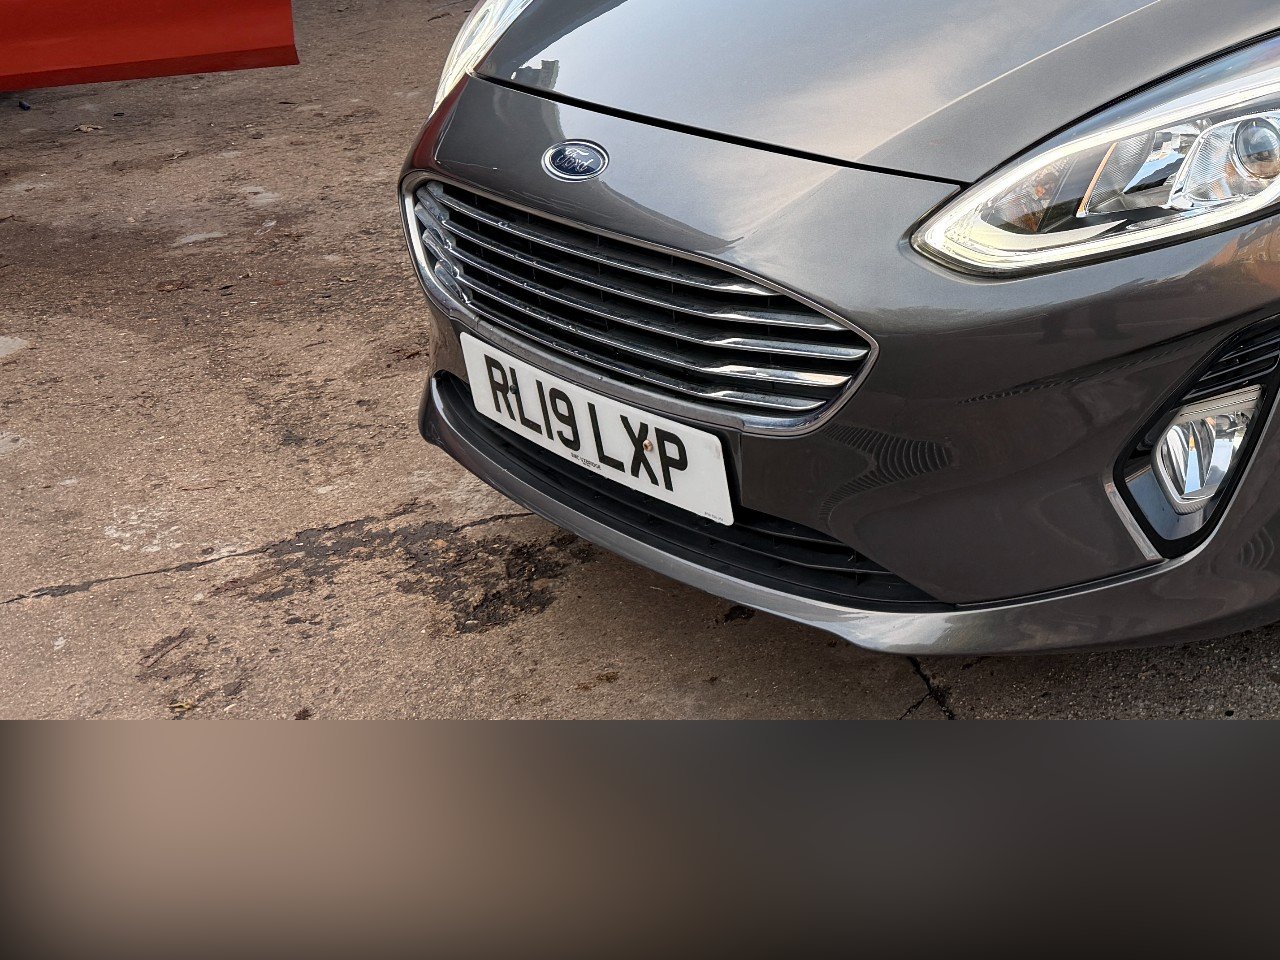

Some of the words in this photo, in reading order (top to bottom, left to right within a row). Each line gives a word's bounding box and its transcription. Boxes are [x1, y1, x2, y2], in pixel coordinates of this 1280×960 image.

[556, 147, 593, 172] Ford
[484, 354, 581, 451] RL19
[587, 402, 688, 492] LXP
